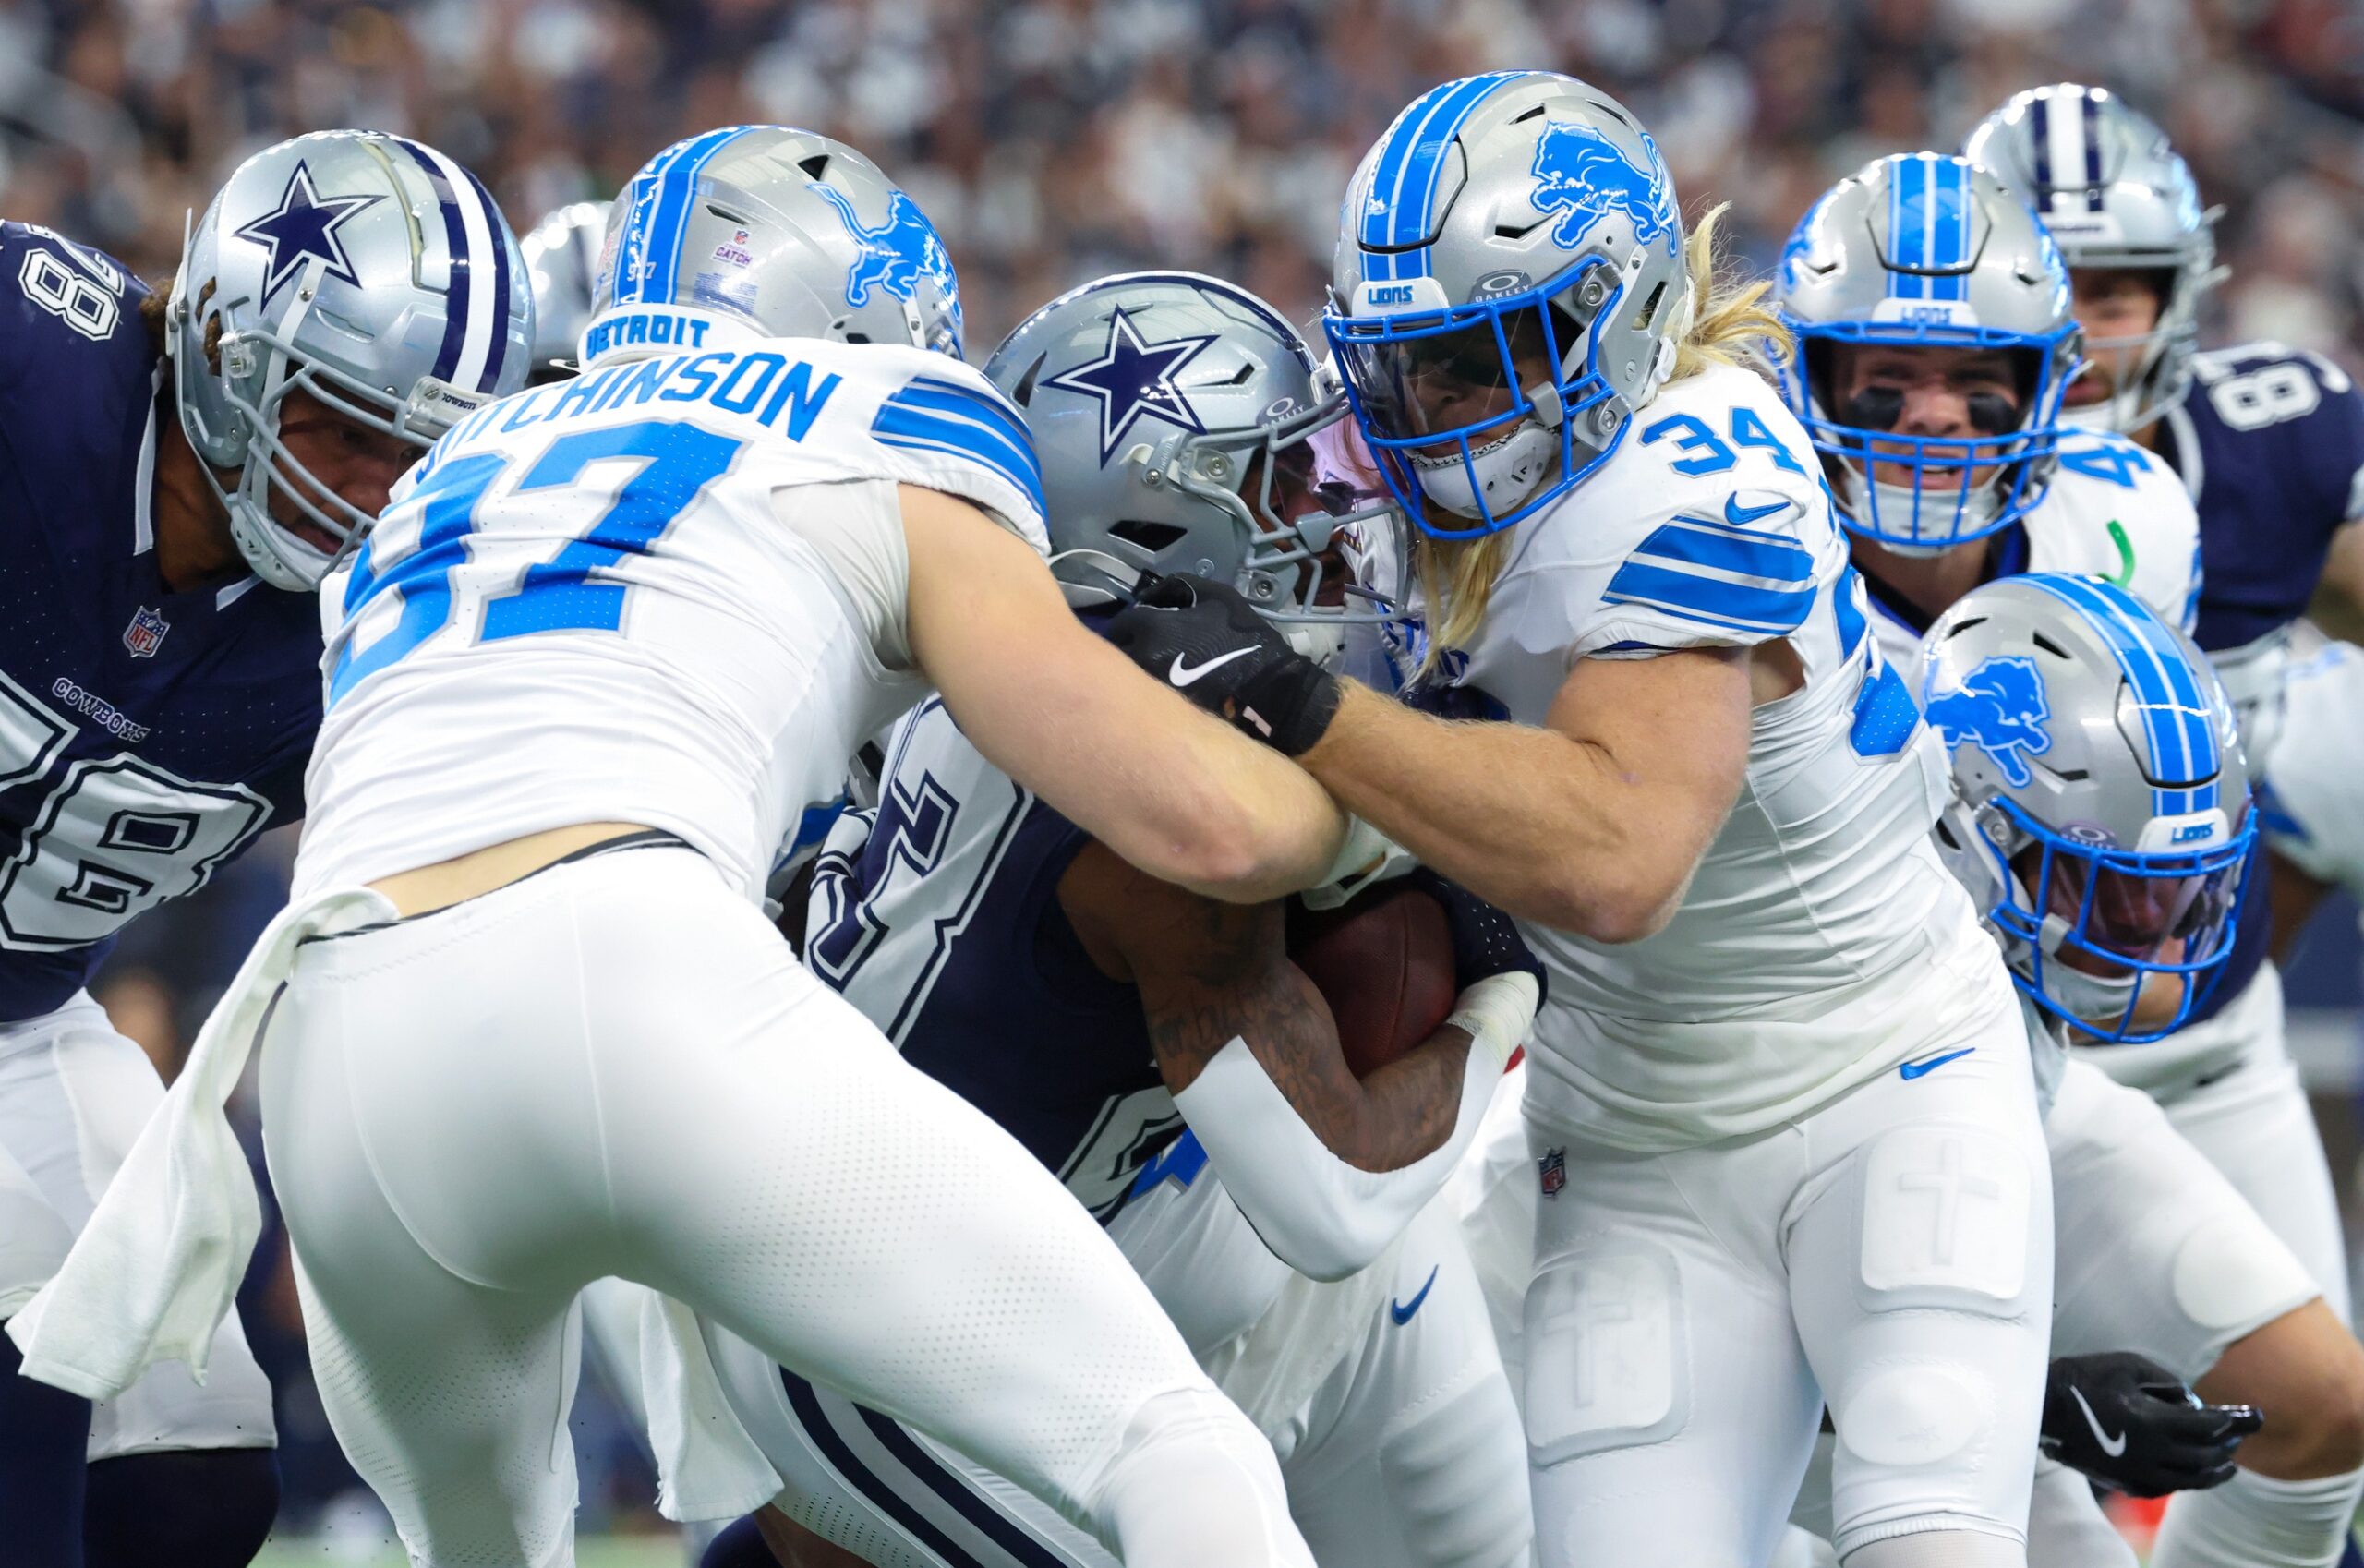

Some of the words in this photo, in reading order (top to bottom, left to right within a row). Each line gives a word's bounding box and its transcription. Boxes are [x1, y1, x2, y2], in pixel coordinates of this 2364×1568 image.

[626, 261, 657, 281] 97
[716, 246, 753, 265] CATCH
[1368, 285, 1413, 305] LIONS
[1475, 285, 1530, 303] OAKLEY
[586, 314, 710, 361] DETROIT
[415, 353, 844, 485] TCHINSON
[1637, 405, 1812, 479] 34
[327, 418, 754, 711] 97
[129, 624, 158, 651] NFL
[52, 677, 151, 742] COWBOYS
